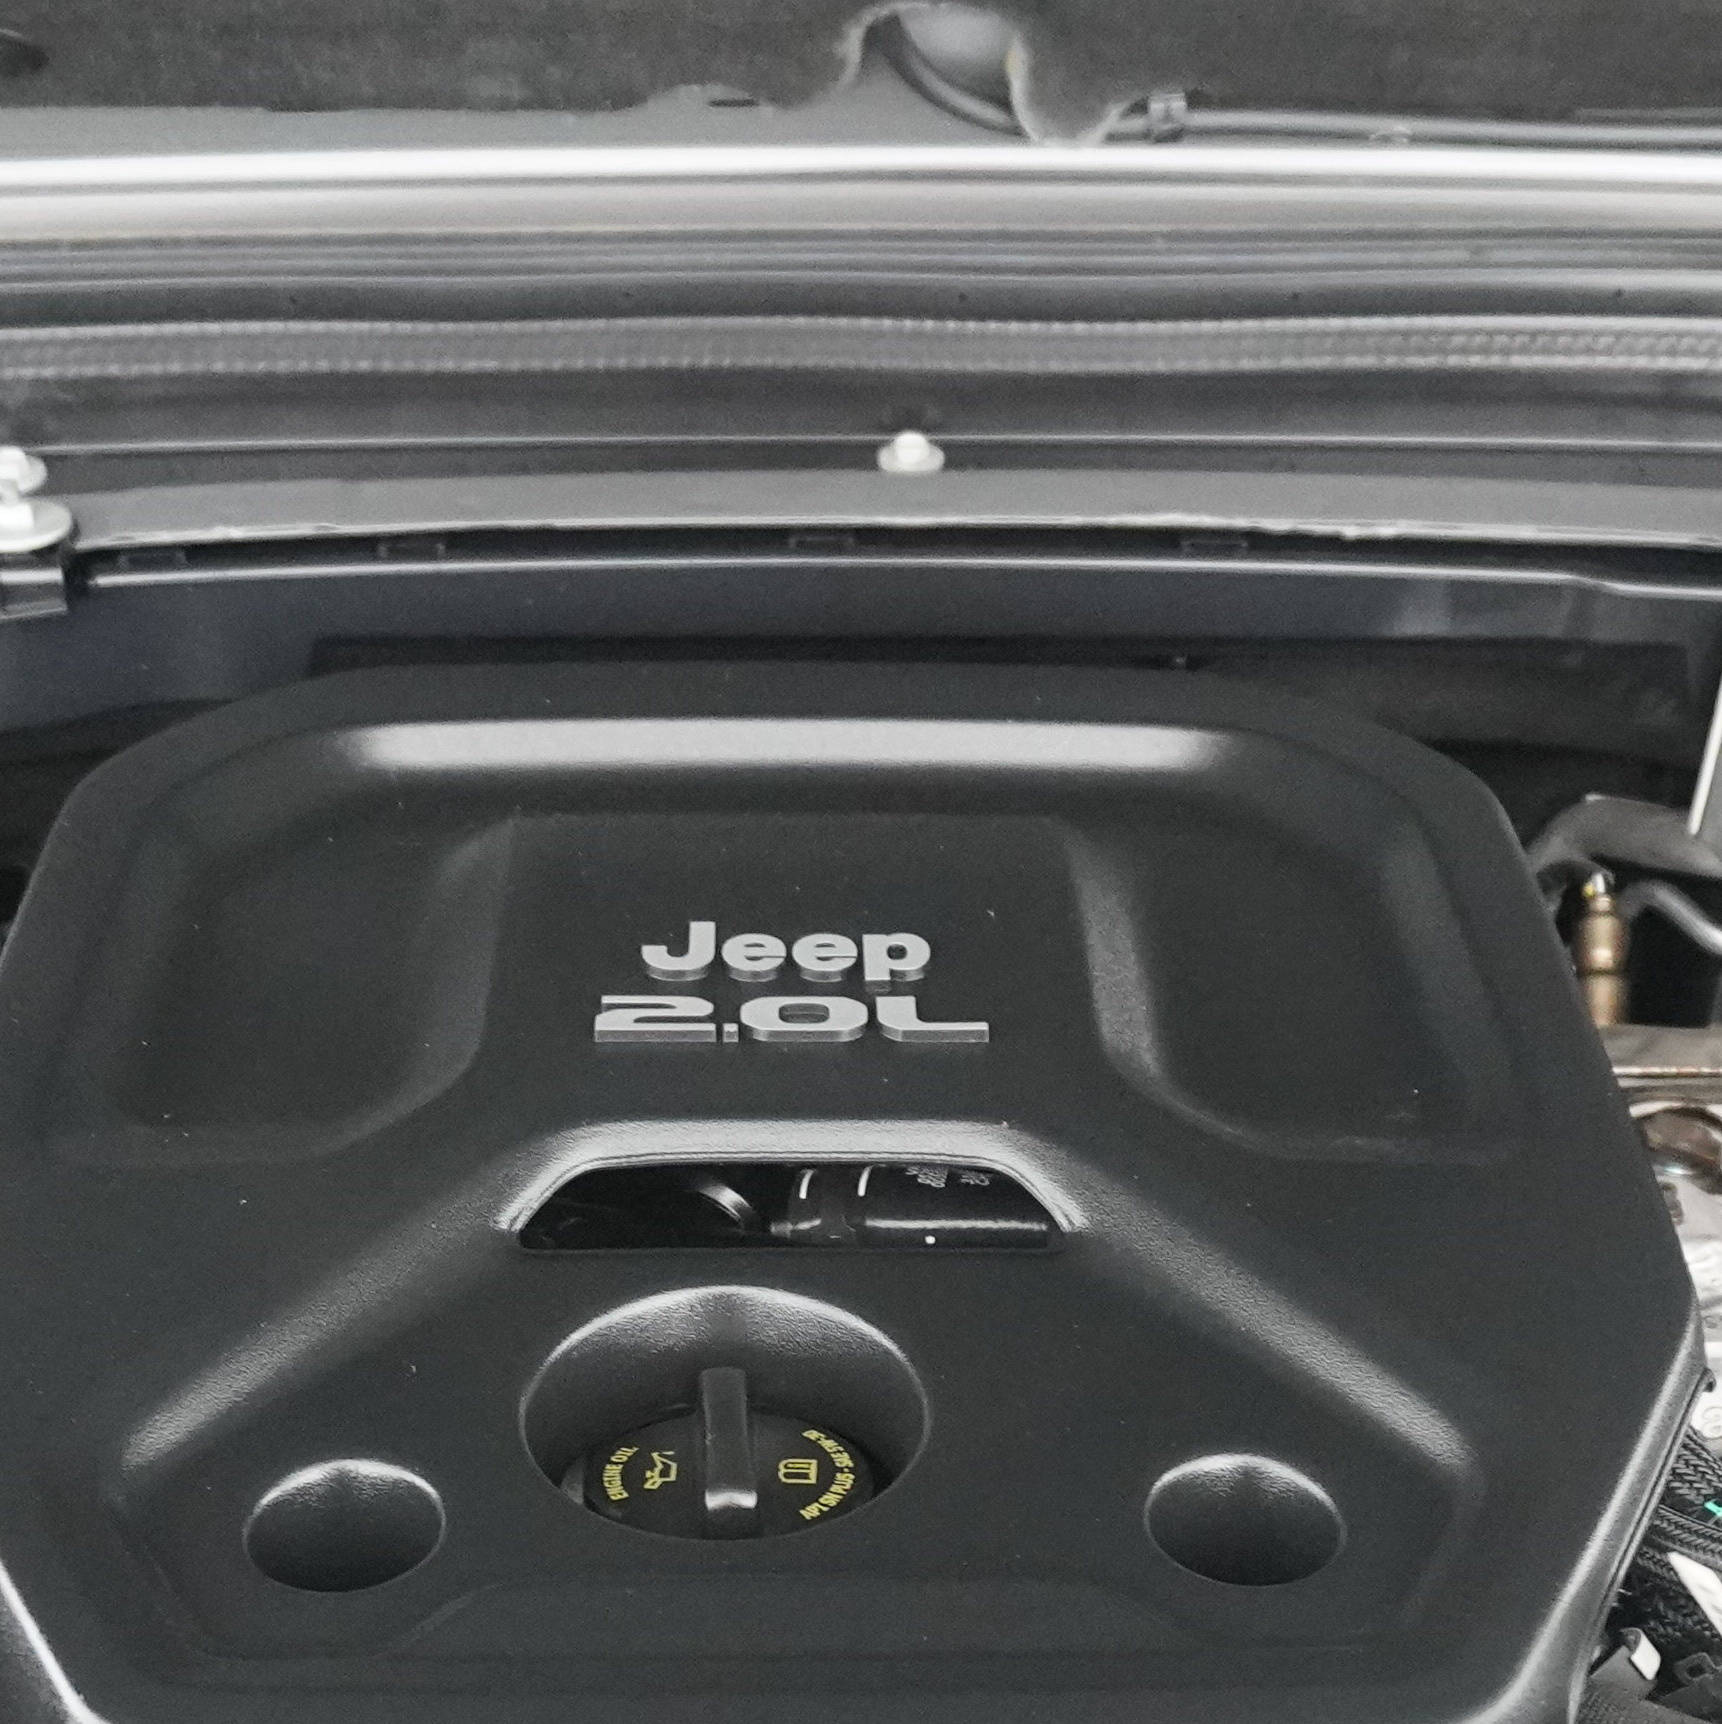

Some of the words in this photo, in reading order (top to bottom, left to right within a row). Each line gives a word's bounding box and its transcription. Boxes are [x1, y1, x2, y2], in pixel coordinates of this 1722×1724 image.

[641, 921, 931, 990] Jeep
[594, 995, 990, 1042] 2.0L
[610, 1447, 640, 1463] OIL
[602, 1463, 630, 1501] ENGINE
